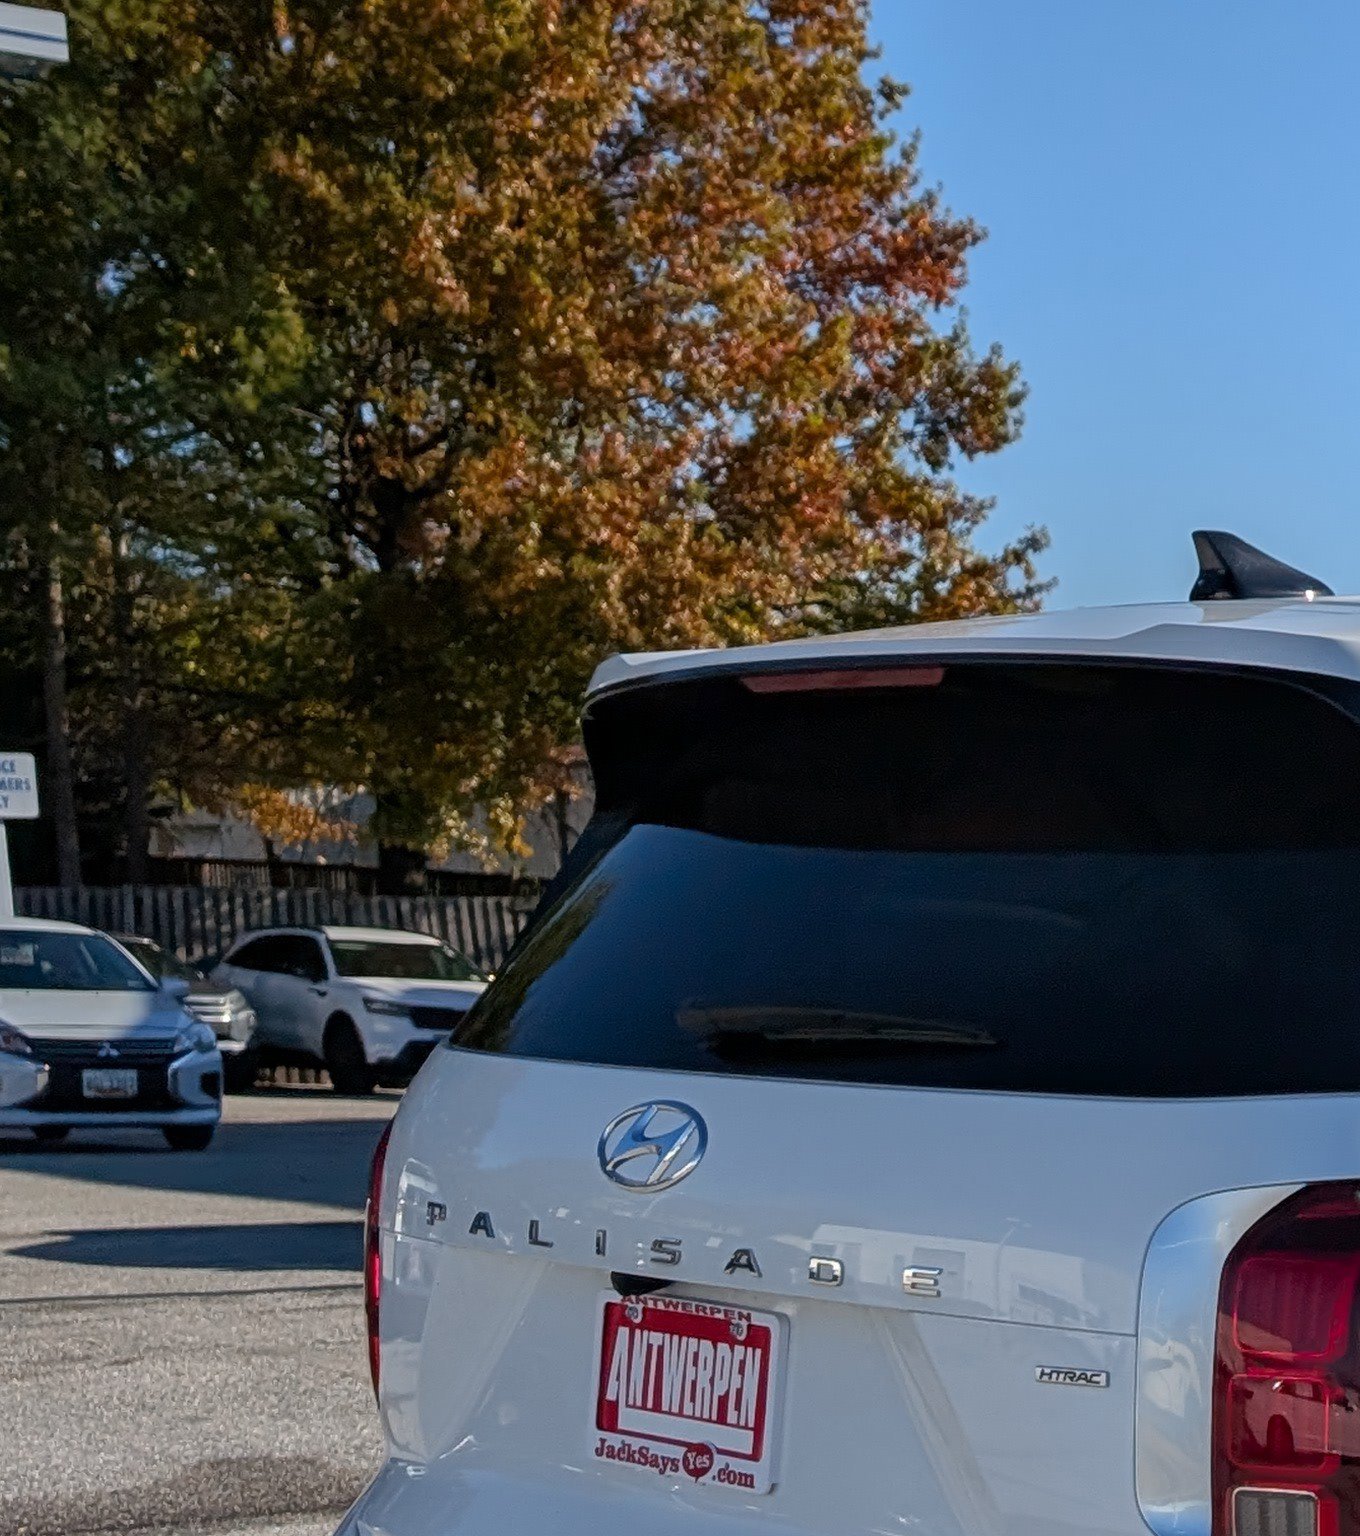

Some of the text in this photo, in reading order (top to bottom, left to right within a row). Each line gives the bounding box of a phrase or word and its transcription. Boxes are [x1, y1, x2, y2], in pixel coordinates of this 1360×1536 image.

[426, 1201, 944, 1298] PALISADE
[621, 1295, 752, 1322] ANTWERPEN
[605, 1326, 762, 1428] ANTWERPEN
[1039, 1368, 1102, 1384] HTRAC
